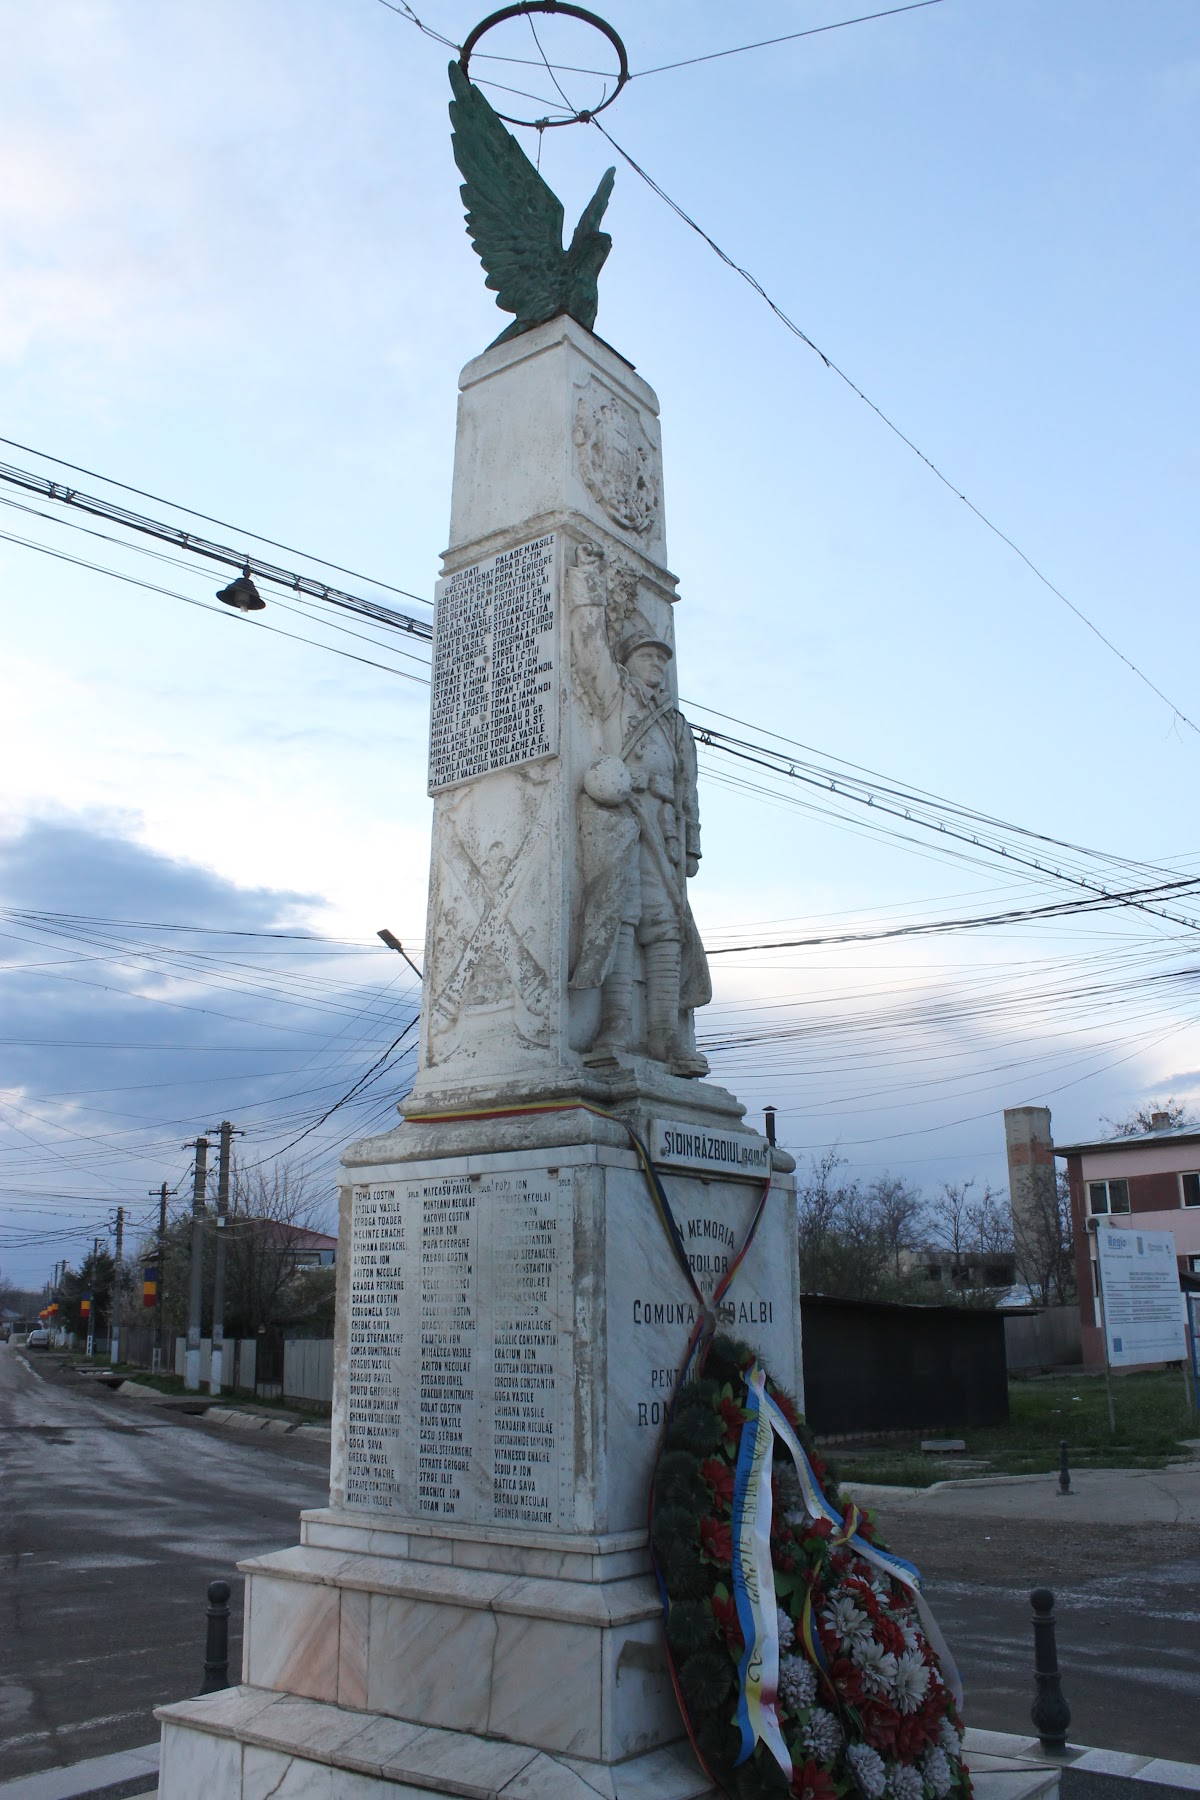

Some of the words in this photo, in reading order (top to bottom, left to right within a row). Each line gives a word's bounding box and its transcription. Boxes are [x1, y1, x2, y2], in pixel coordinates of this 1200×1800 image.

[688, 1219, 735, 1249] MEMORIA
[688, 1254, 729, 1274] ROILOR
[633, 1299, 695, 1325] COMUNA
